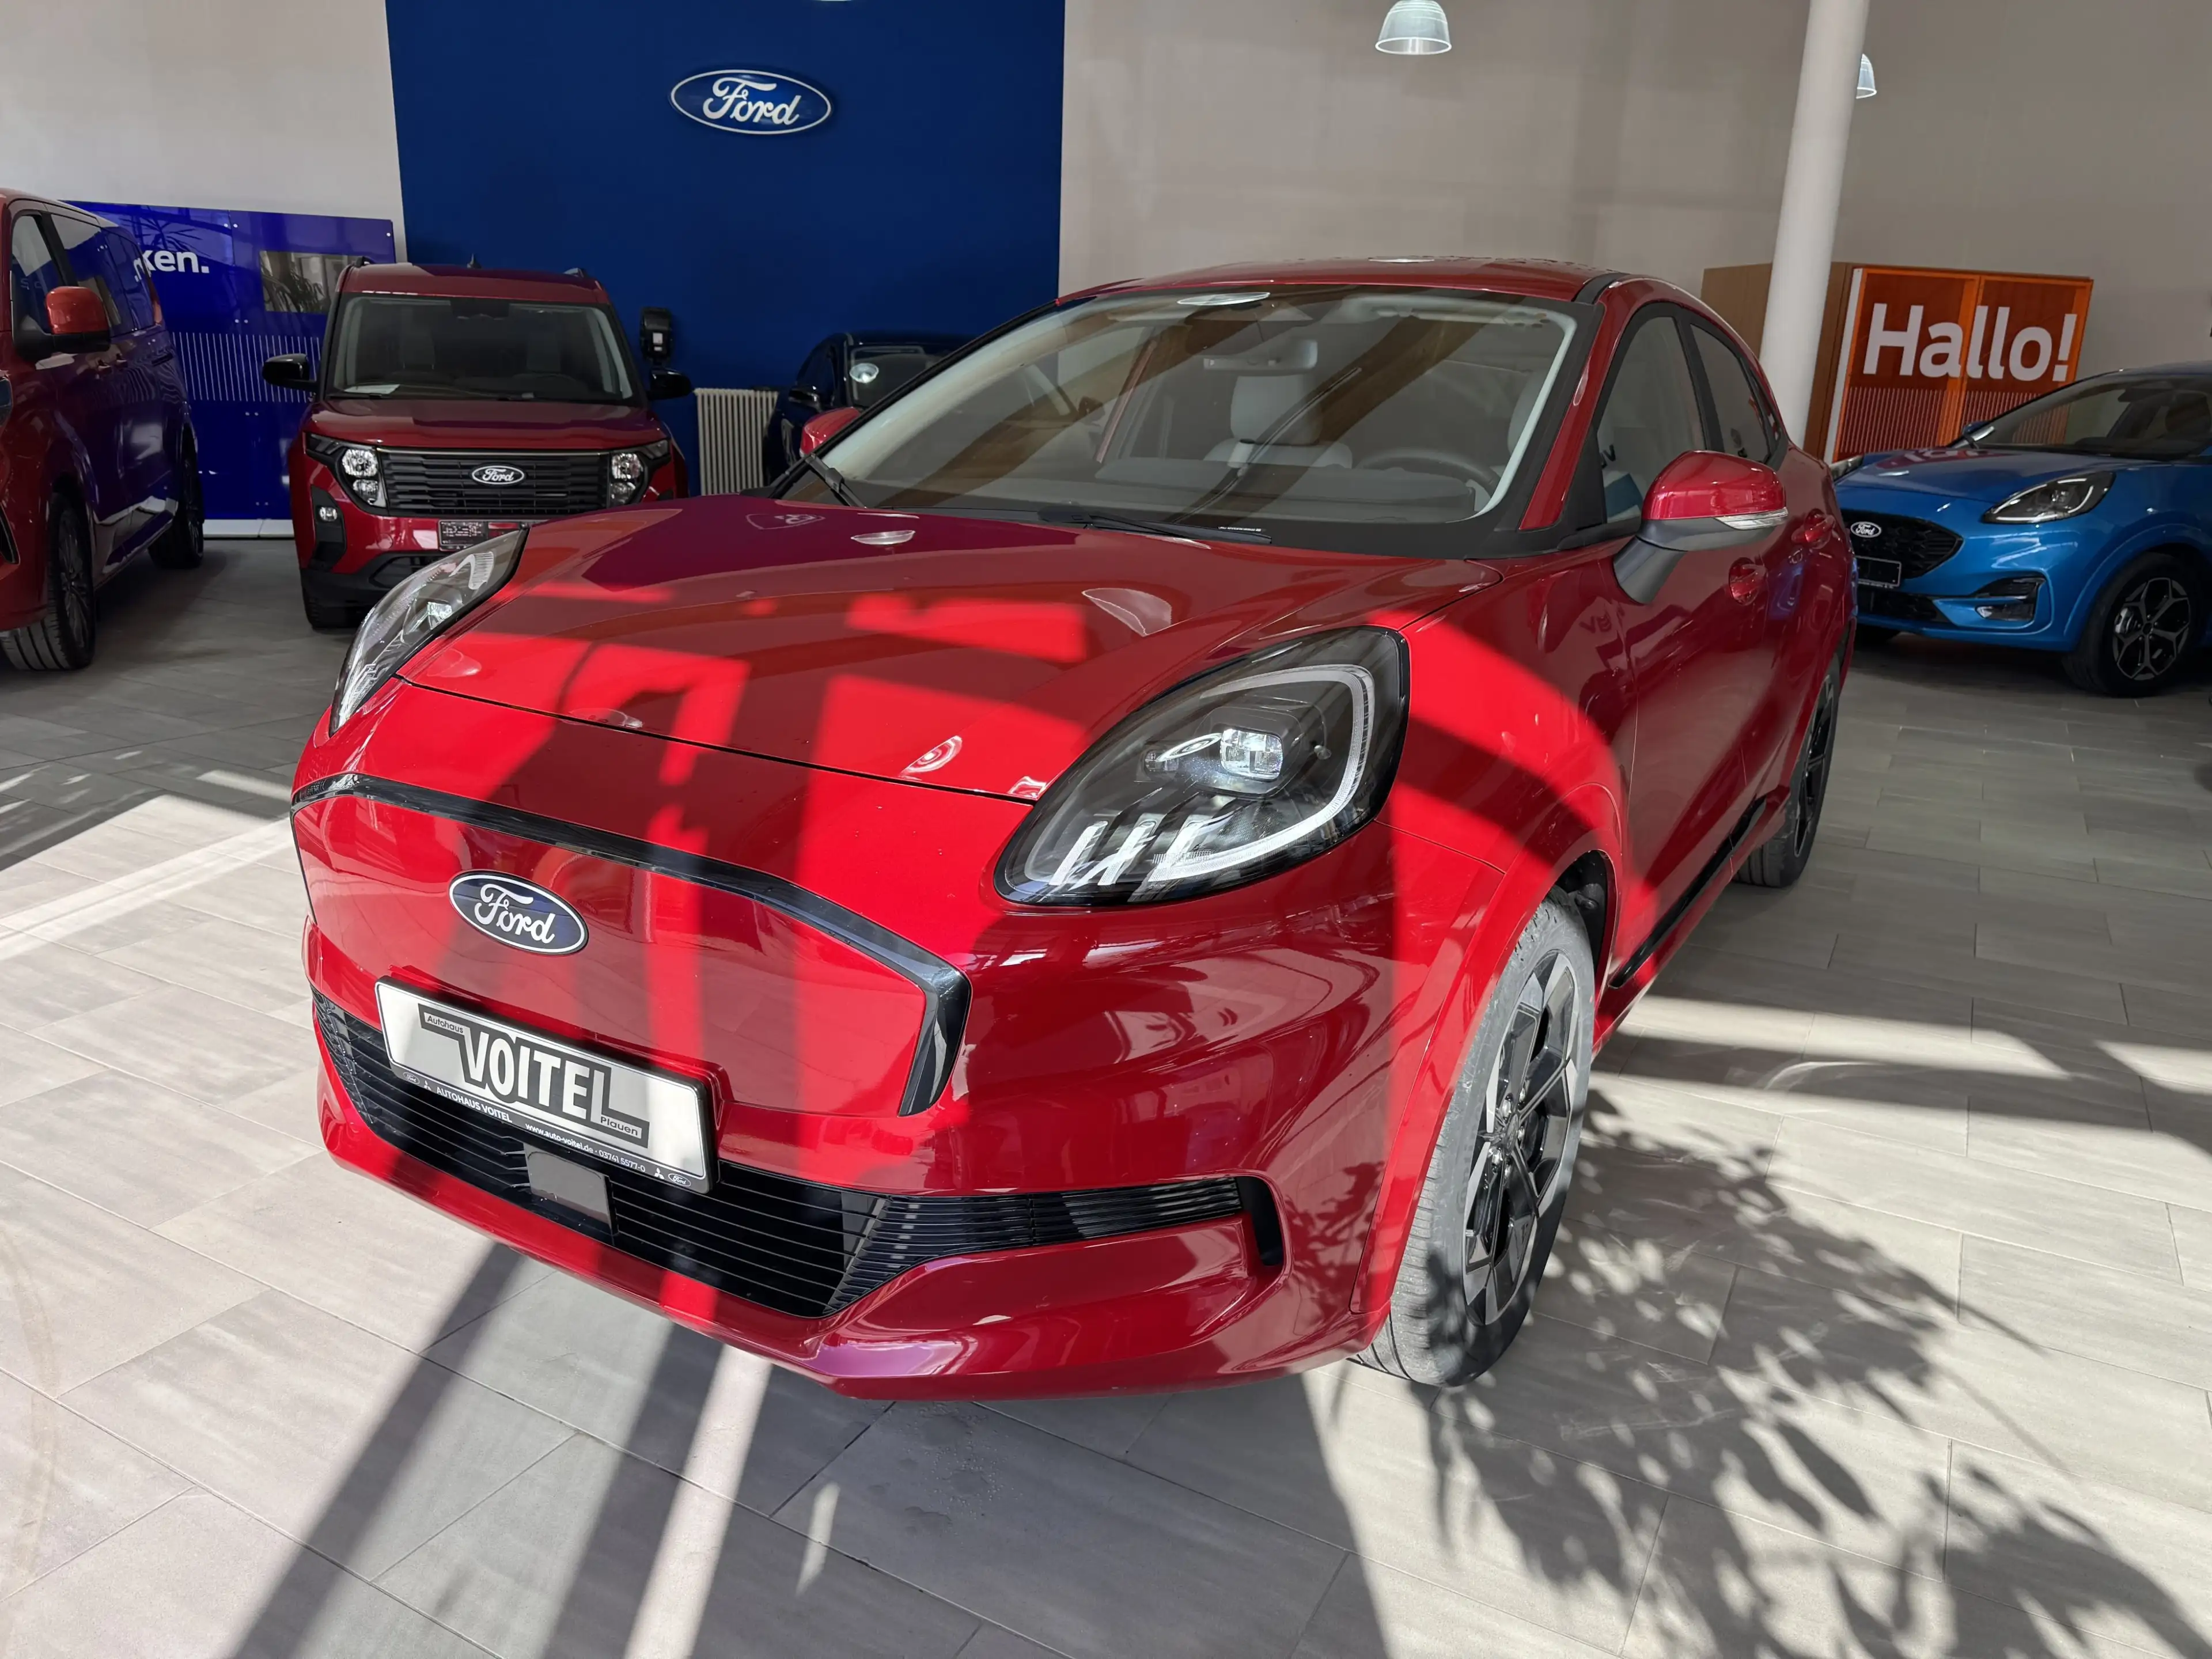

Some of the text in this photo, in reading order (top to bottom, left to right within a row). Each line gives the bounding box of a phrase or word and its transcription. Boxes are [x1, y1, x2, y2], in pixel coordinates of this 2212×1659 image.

[703, 77, 801, 125] Ford
[1863, 303, 2077, 381] Hallo!
[482, 467, 514, 482] Ford
[1855, 524, 1876, 536] Ford
[474, 884, 556, 944] Ford
[427, 1015, 463, 1033] Autohaus
[463, 1030, 605, 1122] VOITEL
[437, 1086, 480, 1109] AUTOHAUS
[481, 1104, 513, 1123] VOITEL
[525, 1123, 593, 1153] www.auto-voitel.de
[620, 1157, 646, 1172] 5577-0
[600, 1116, 638, 1136] Plauen
